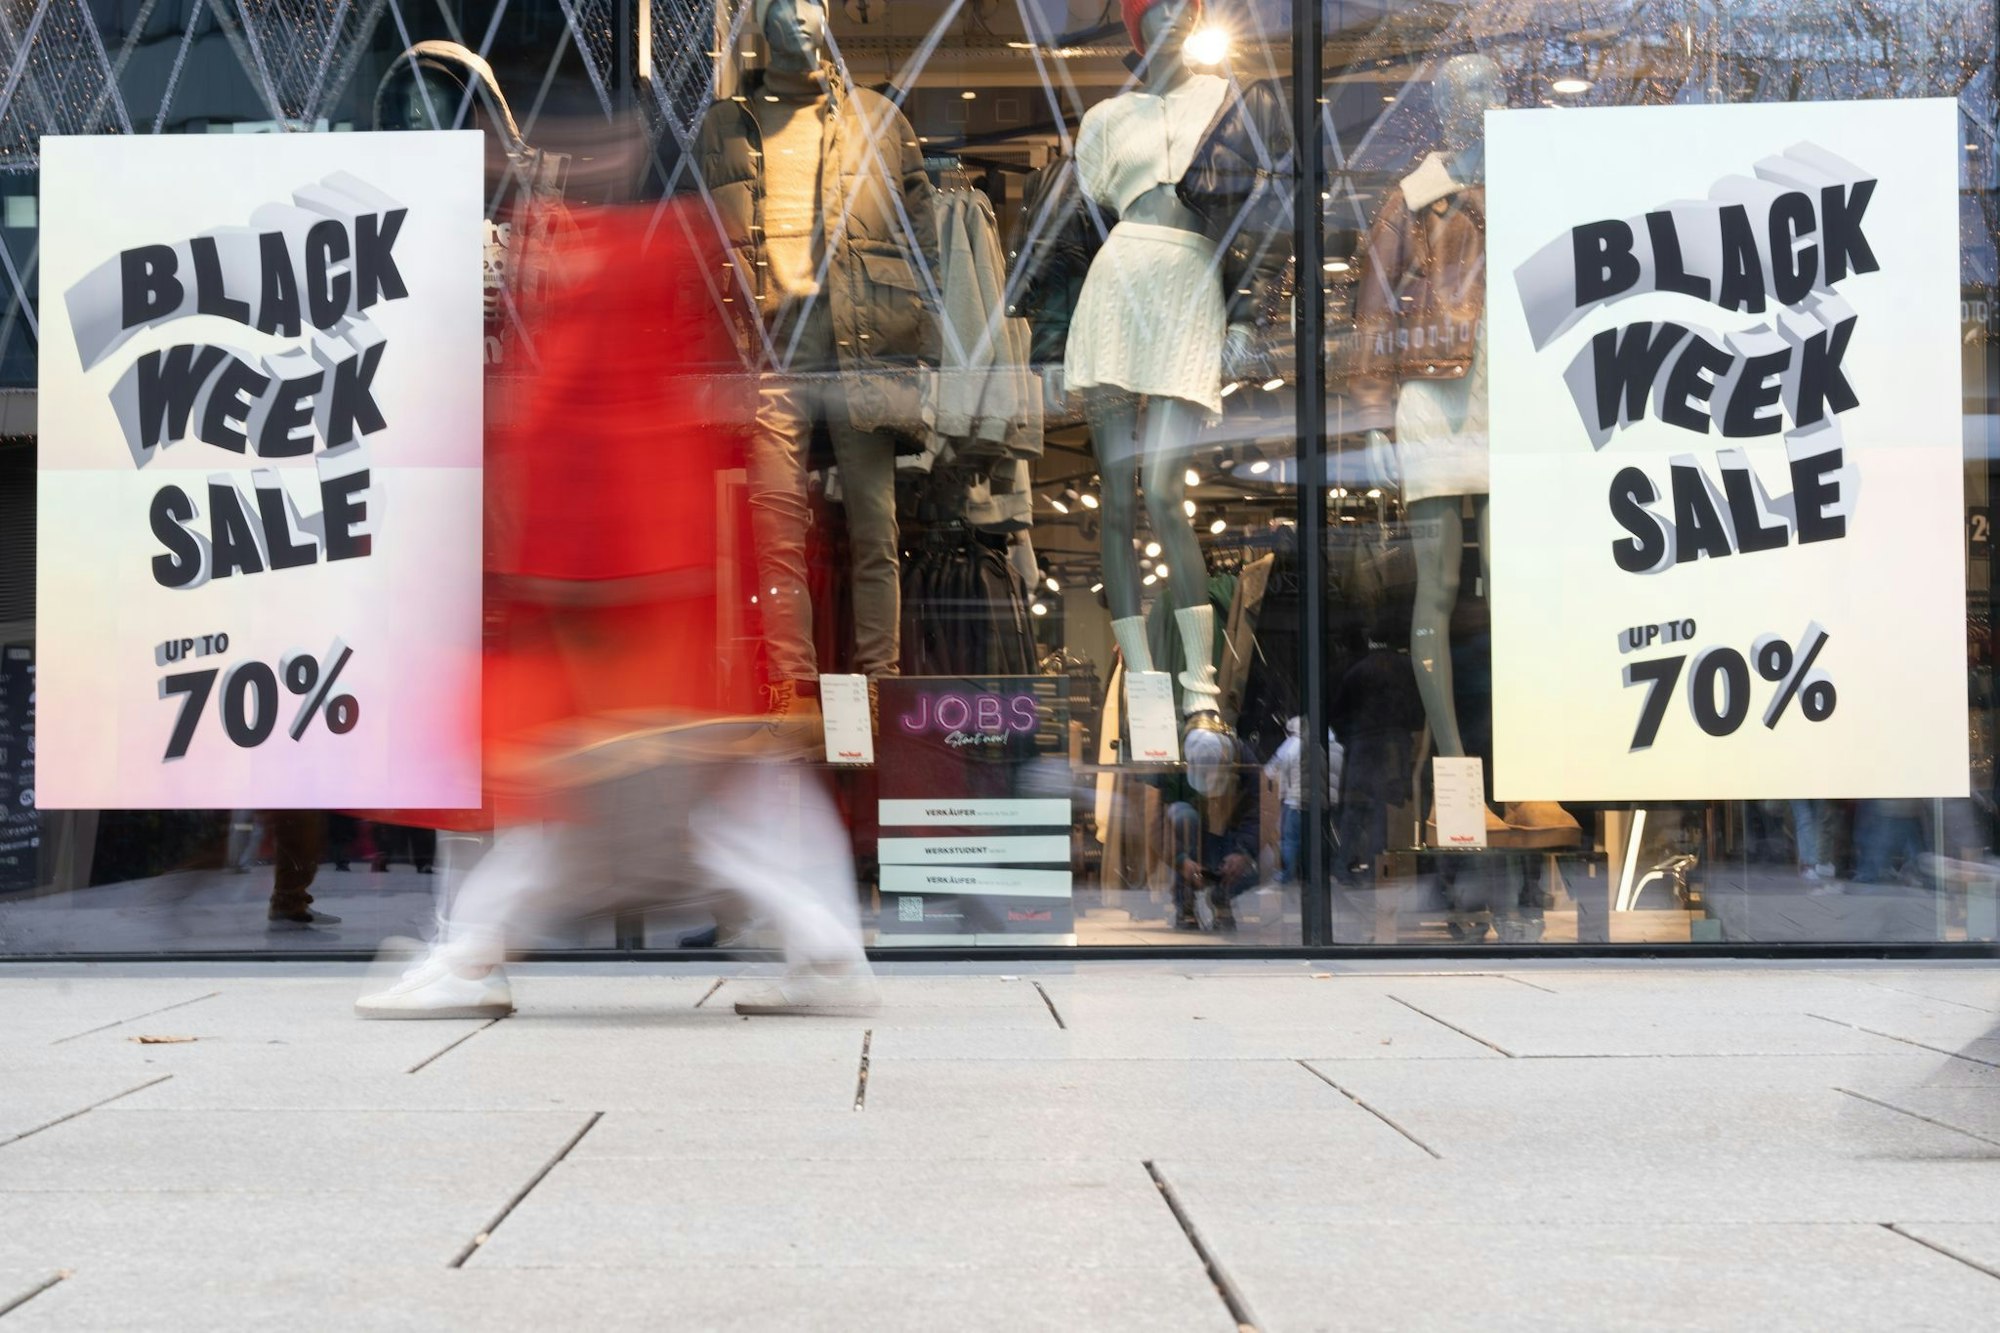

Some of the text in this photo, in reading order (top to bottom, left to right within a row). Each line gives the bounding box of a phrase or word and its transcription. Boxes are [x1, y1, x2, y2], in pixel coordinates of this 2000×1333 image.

[120, 208, 409, 338] BLACK
[1572, 179, 1880, 314] BLACK
[137, 341, 387, 457] WEEK
[1592, 315, 1860, 438] WEEK
[149, 470, 371, 588] SALE
[1609, 448, 1846, 573] SALE
[165, 633, 229, 661] UP TO
[1629, 618, 1696, 648] UP TO
[1629, 631, 1837, 749] 70%
[164, 647, 360, 760] 70%
[903, 695, 1035, 732] JOBS
[924, 846, 988, 855] WERKSTUDENT
[925, 807, 977, 817] VERKÄUFER
[926, 875, 977, 885] VERKÄUFER
